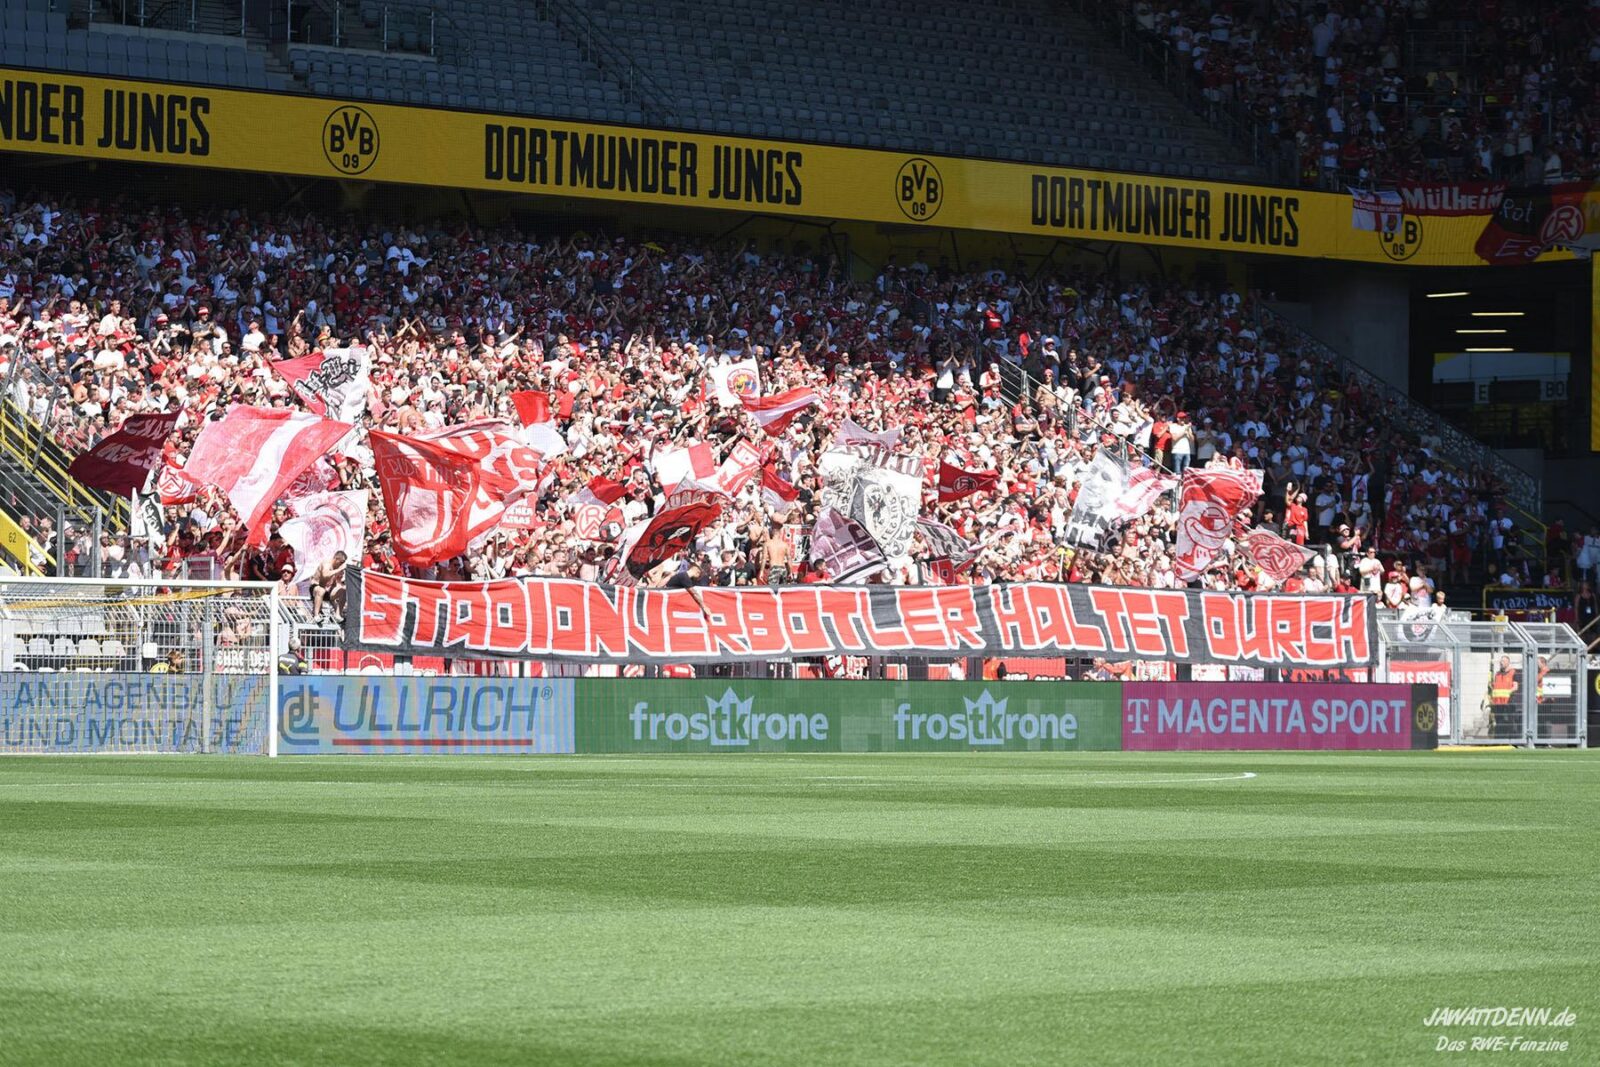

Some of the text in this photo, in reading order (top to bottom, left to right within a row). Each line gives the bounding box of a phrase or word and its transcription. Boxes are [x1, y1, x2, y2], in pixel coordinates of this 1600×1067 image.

[97, 89, 211, 156] JUNGS
[330, 111, 375, 156] BVB
[342, 153, 359, 169] 09
[485, 124, 802, 206] DORTMUNDER JUNGS
[901, 163, 939, 205] BVB
[912, 201, 927, 216] 09
[1031, 174, 1299, 248] DORTMUNDER JUNGS
[8, 531, 17, 543] 62
[358, 568, 1370, 664] STADIONVERBOTLER HALTET DURCH
[4, 717, 75, 746] UND
[629, 702, 829, 742] frostkrone
[894, 703, 1078, 741] frostkrone
[1157, 698, 1306, 734] MAGENTA
[1311, 698, 1406, 735] SPORT
